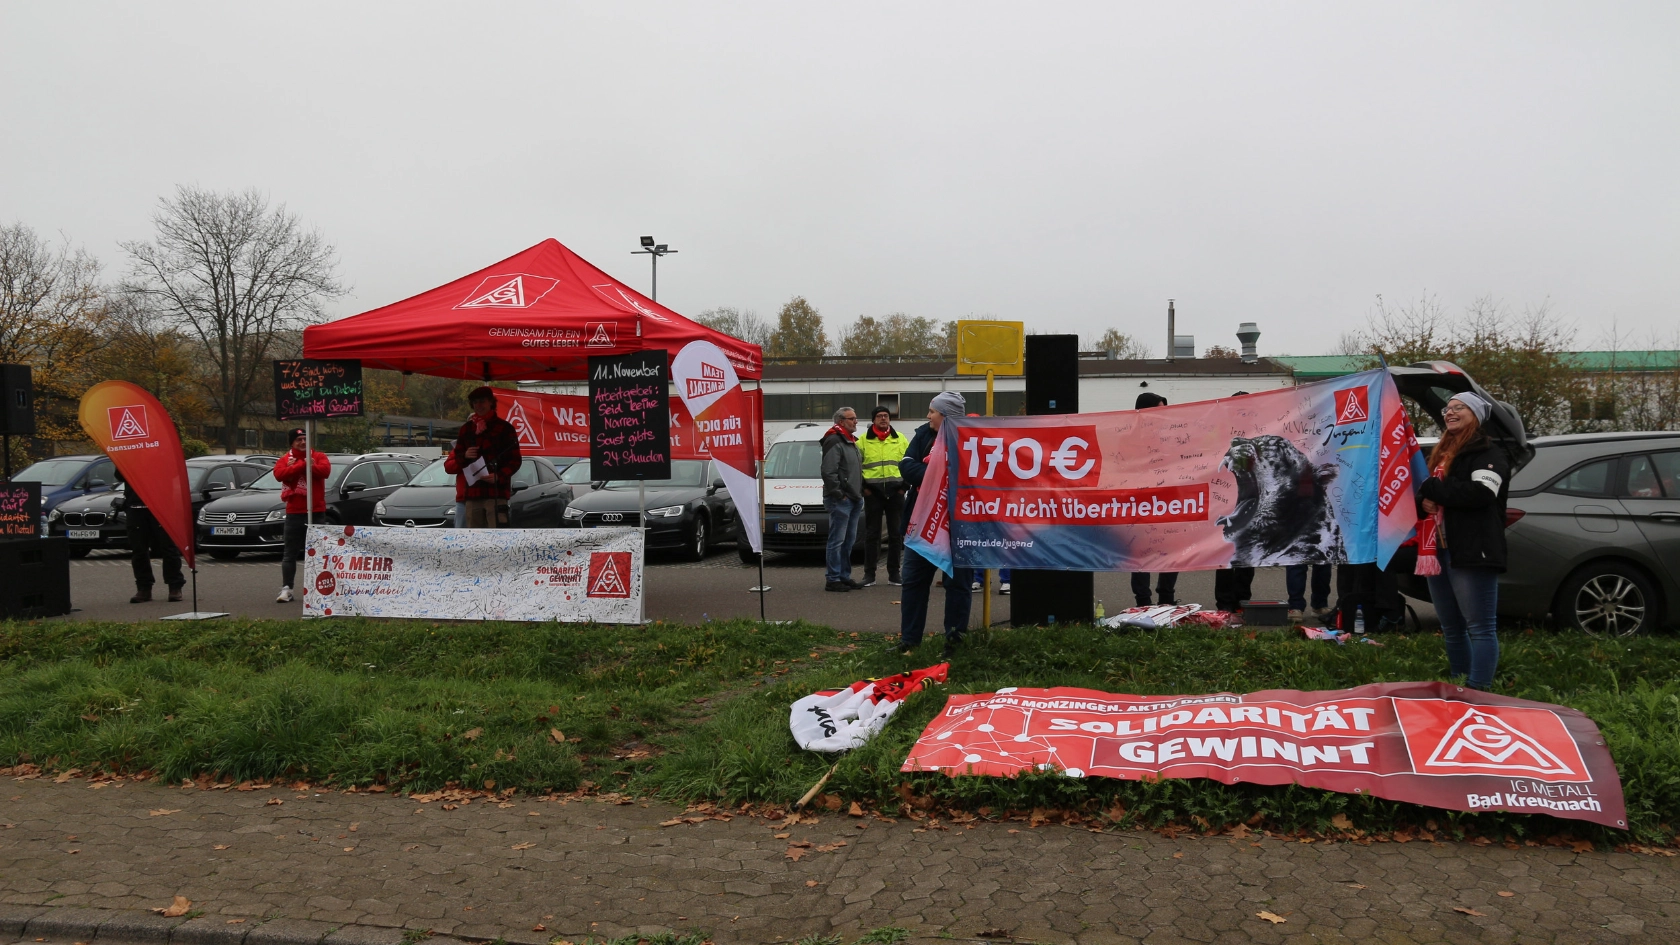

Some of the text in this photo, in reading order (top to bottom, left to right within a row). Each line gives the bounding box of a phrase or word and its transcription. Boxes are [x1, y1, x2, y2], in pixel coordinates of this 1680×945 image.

[488, 327, 581, 339] GEMEINSAM FÜR EIN
[521, 339, 579, 348] GUTES LEBEN
[593, 361, 660, 380] 11. November
[598, 402, 624, 416] Seid
[602, 450, 619, 467] 24
[962, 436, 1096, 480] 170 €
[1211, 478, 1232, 489] LEVIN
[961, 491, 1205, 519] sind nicht übertrieben!
[956, 537, 1034, 550] igmetall.de/jugend
[349, 556, 393, 571] MEHR
[336, 571, 356, 580] NÖTIG
[373, 572, 391, 581] FAIR!
[1021, 699, 1123, 713] MONZINGEN.
[1126, 701, 1178, 712] AKTIV
[1047, 704, 1375, 736] SOLIDARITÄT
[1118, 736, 1375, 766] GEWINNT
[1510, 779, 1598, 798] IG METALL
[1466, 792, 1602, 812] Bad Kreuznach
